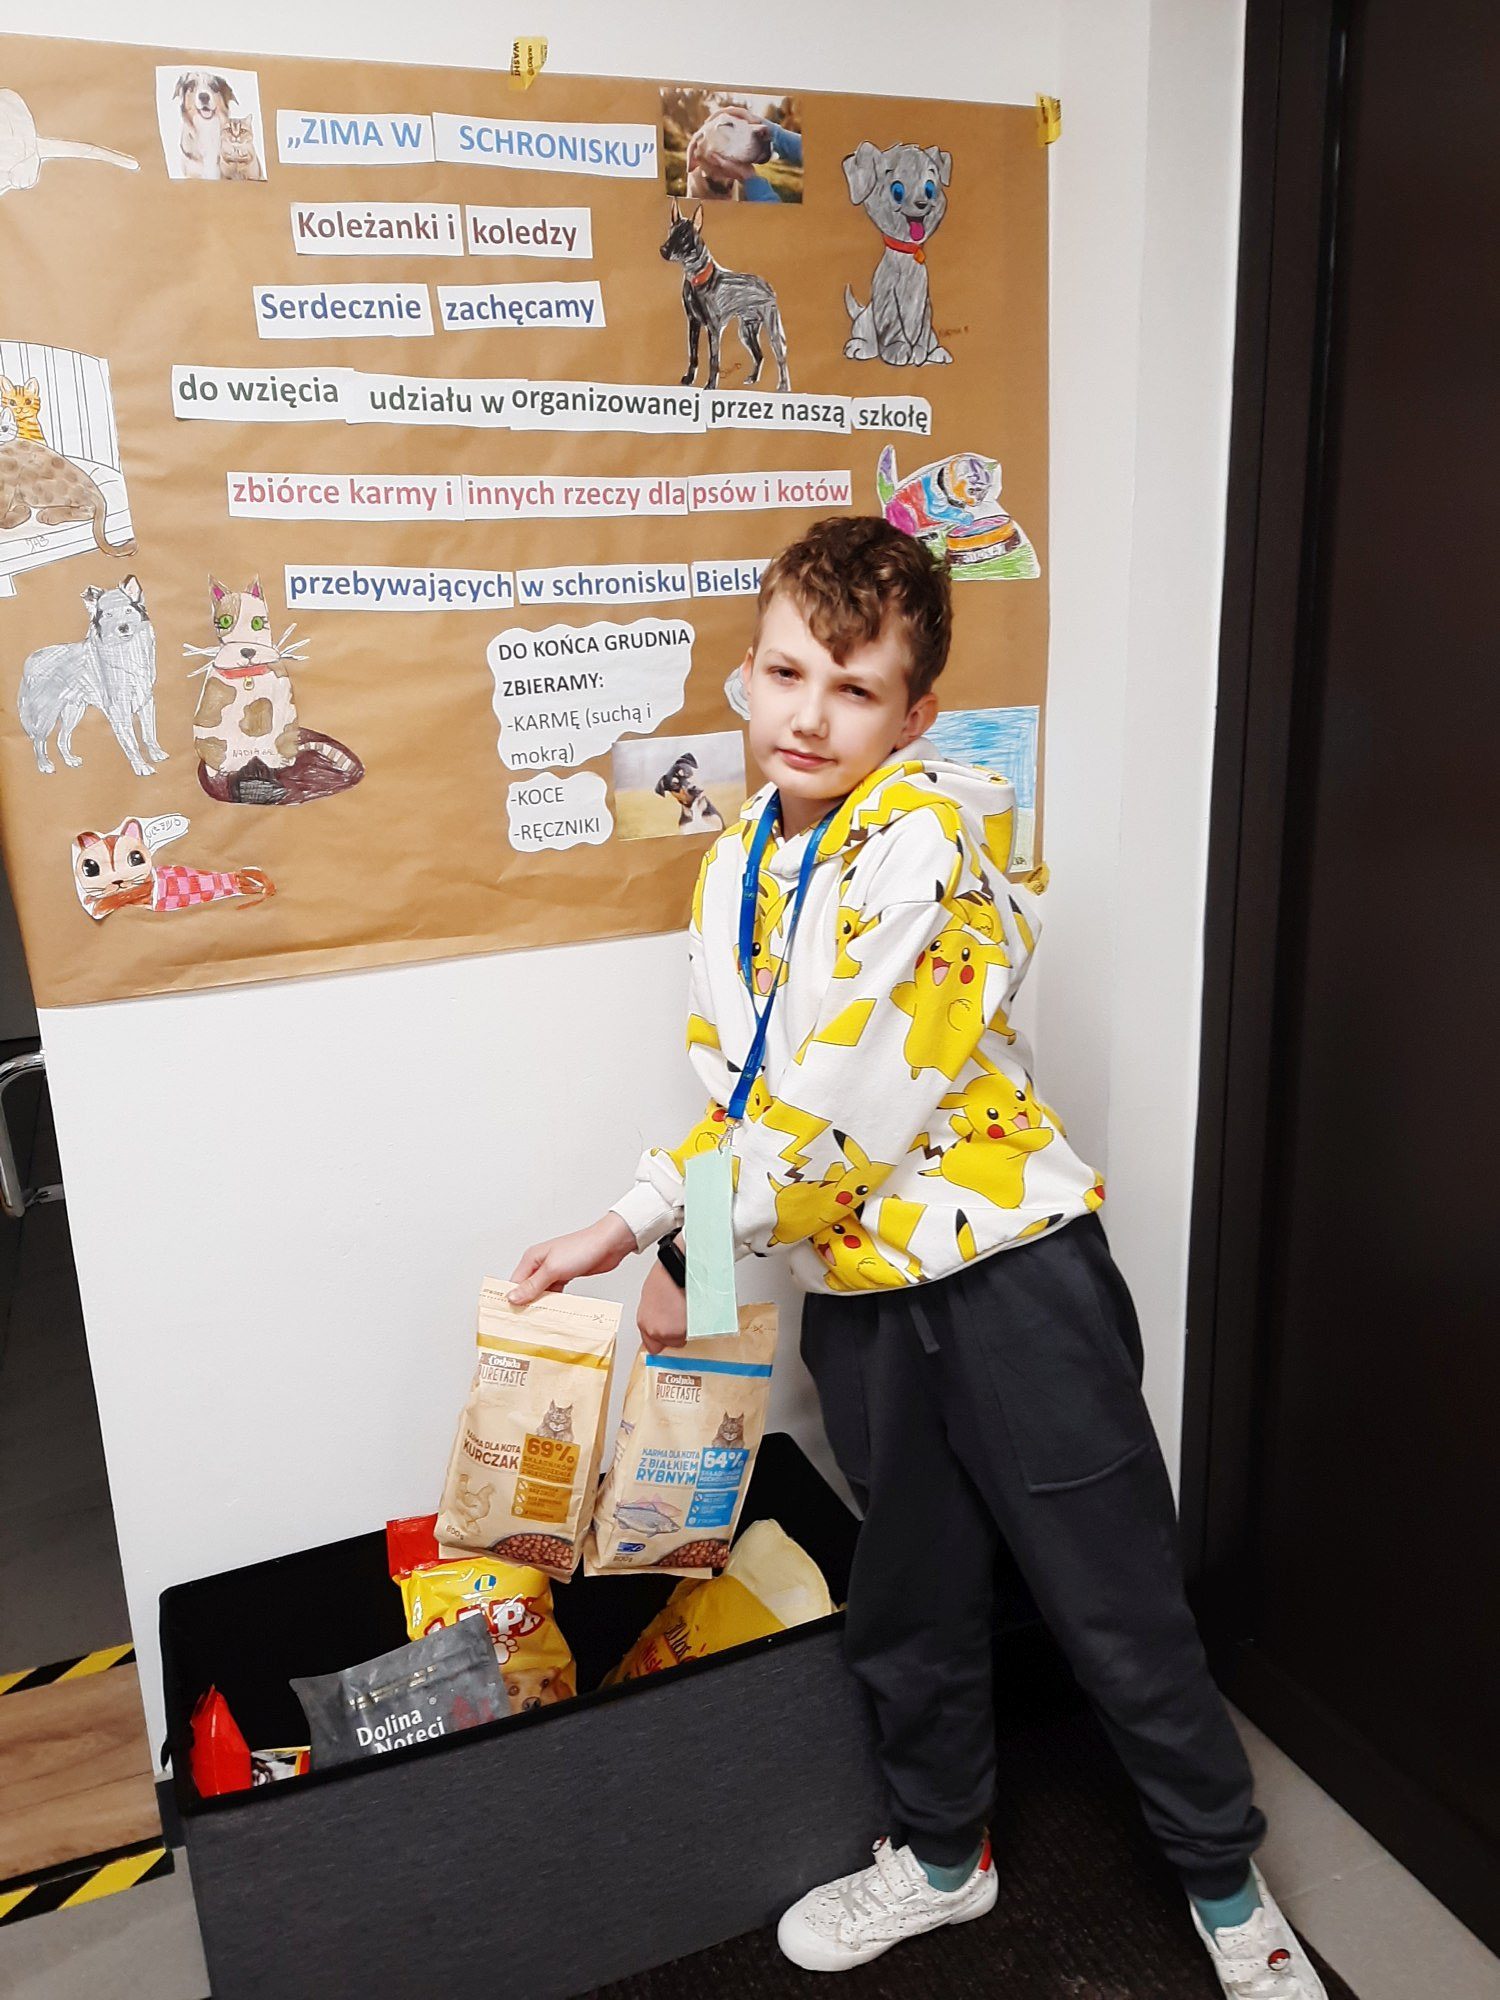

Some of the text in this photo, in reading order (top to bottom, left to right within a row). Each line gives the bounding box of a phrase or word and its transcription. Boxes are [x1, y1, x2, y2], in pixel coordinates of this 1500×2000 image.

[287, 118, 655, 167] „ZIMA W SCHRONISKU”
[298, 212, 577, 251] Koleżanki i koledzy
[262, 292, 595, 325] Serdecznie zachęcamy
[179, 374, 928, 432] do wzięcia udziału w organizowanej przez naszą szkołę
[233, 476, 849, 511] zbiórce karmy i innych rzeczy dla psów i kotów
[291, 570, 512, 603] przebywających
[521, 578, 544, 597] w
[552, 568, 686, 596] schronisku
[499, 628, 691, 660] DO KOŃCA GRUDNIA
[503, 673, 605, 697] ZBIERAMY:
[507, 703, 652, 732] -KARMĘ (suchą i
[511, 743, 575, 766] mokrą)
[511, 787, 564, 806] -KOCE
[514, 817, 600, 842] -RĘCZNIKI
[463, 1438, 520, 1470] KURCZAK
[485, 1441, 499, 1451] DLA
[501, 1443, 521, 1453] KOTA
[526, 1437, 575, 1464] 69%
[642, 1448, 700, 1459] KARMA DLA KOTA
[704, 1450, 744, 1469] 64%
[635, 1467, 698, 1486] RYBNYM
[639, 1457, 699, 1471] Z BIAŁKIEM
[356, 1709, 423, 1747] Dolina
